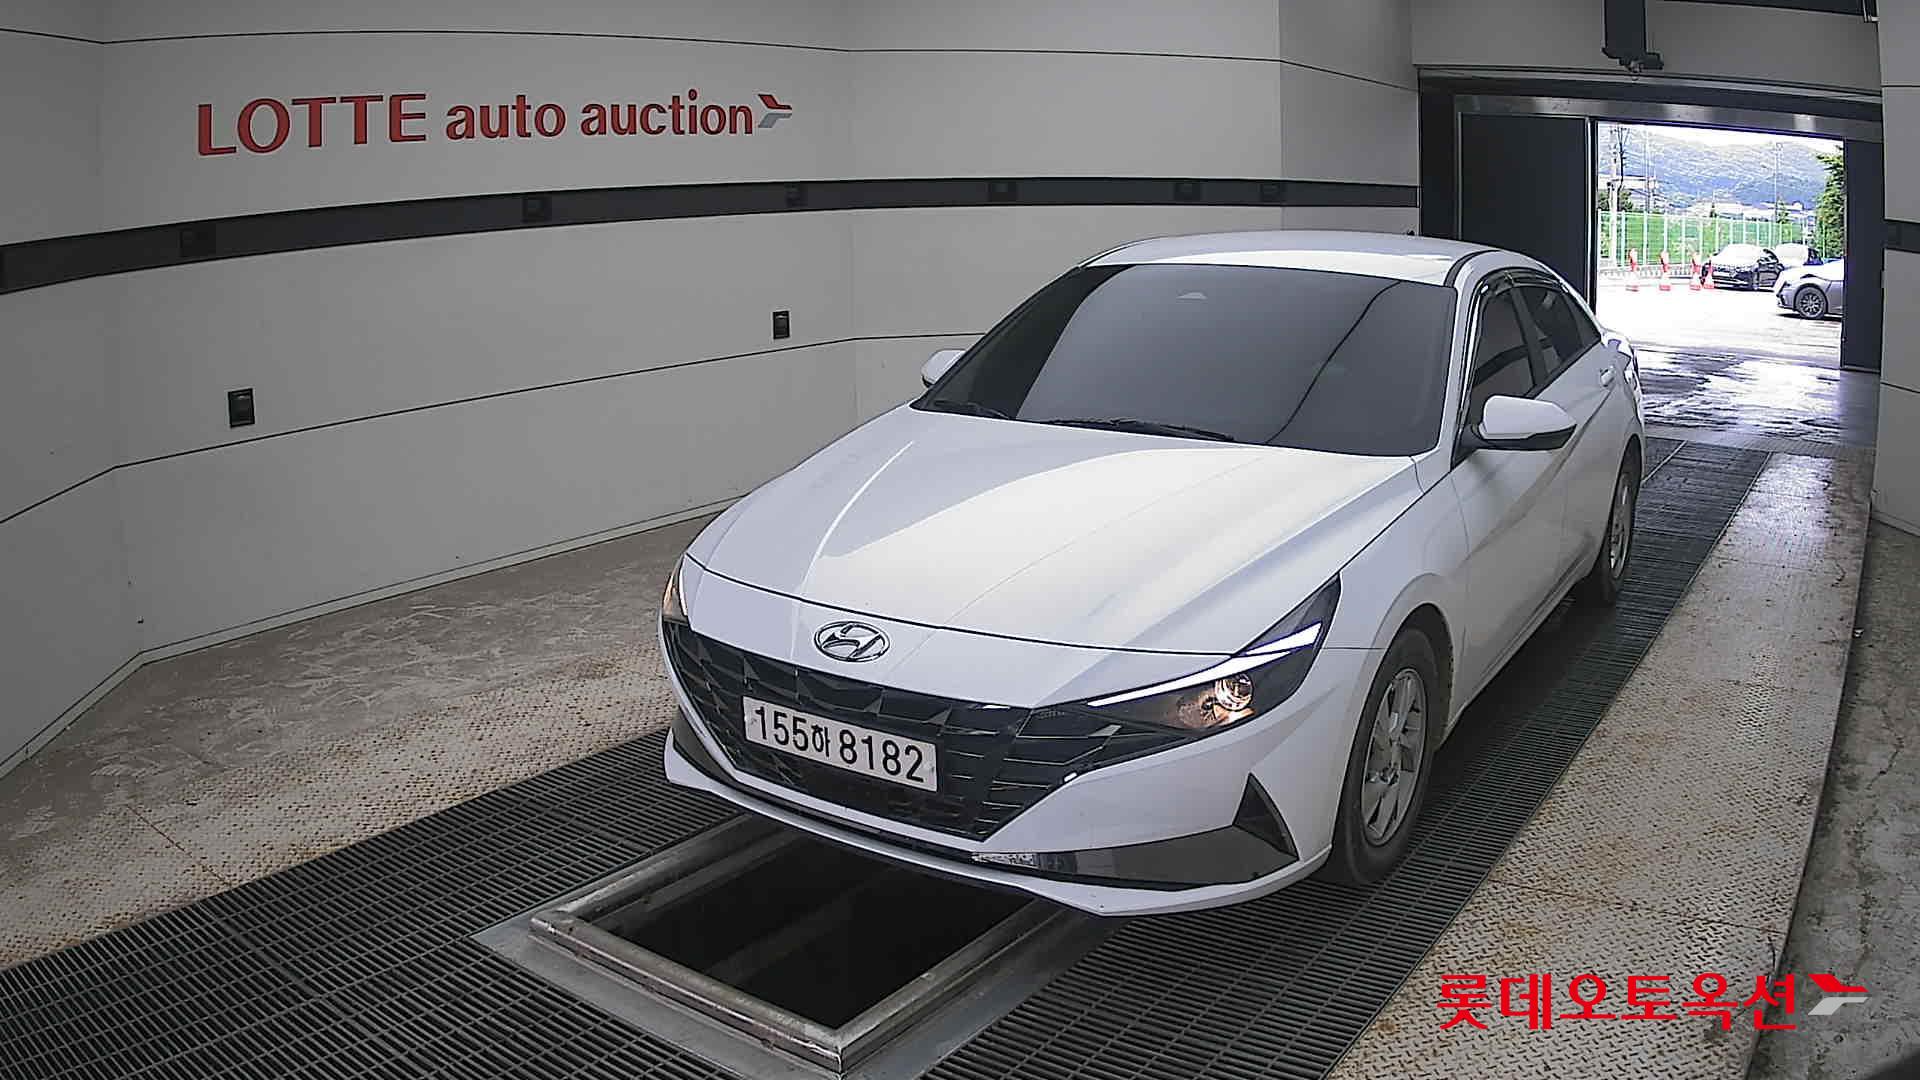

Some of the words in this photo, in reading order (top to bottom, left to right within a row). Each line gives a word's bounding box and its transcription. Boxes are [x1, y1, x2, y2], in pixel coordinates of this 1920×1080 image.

[197, 93, 428, 156] LOTTE
[444, 94, 567, 141] auto
[580, 87, 753, 137] auction
[754, 705, 831, 758] 155하
[838, 729, 925, 783] 8182
